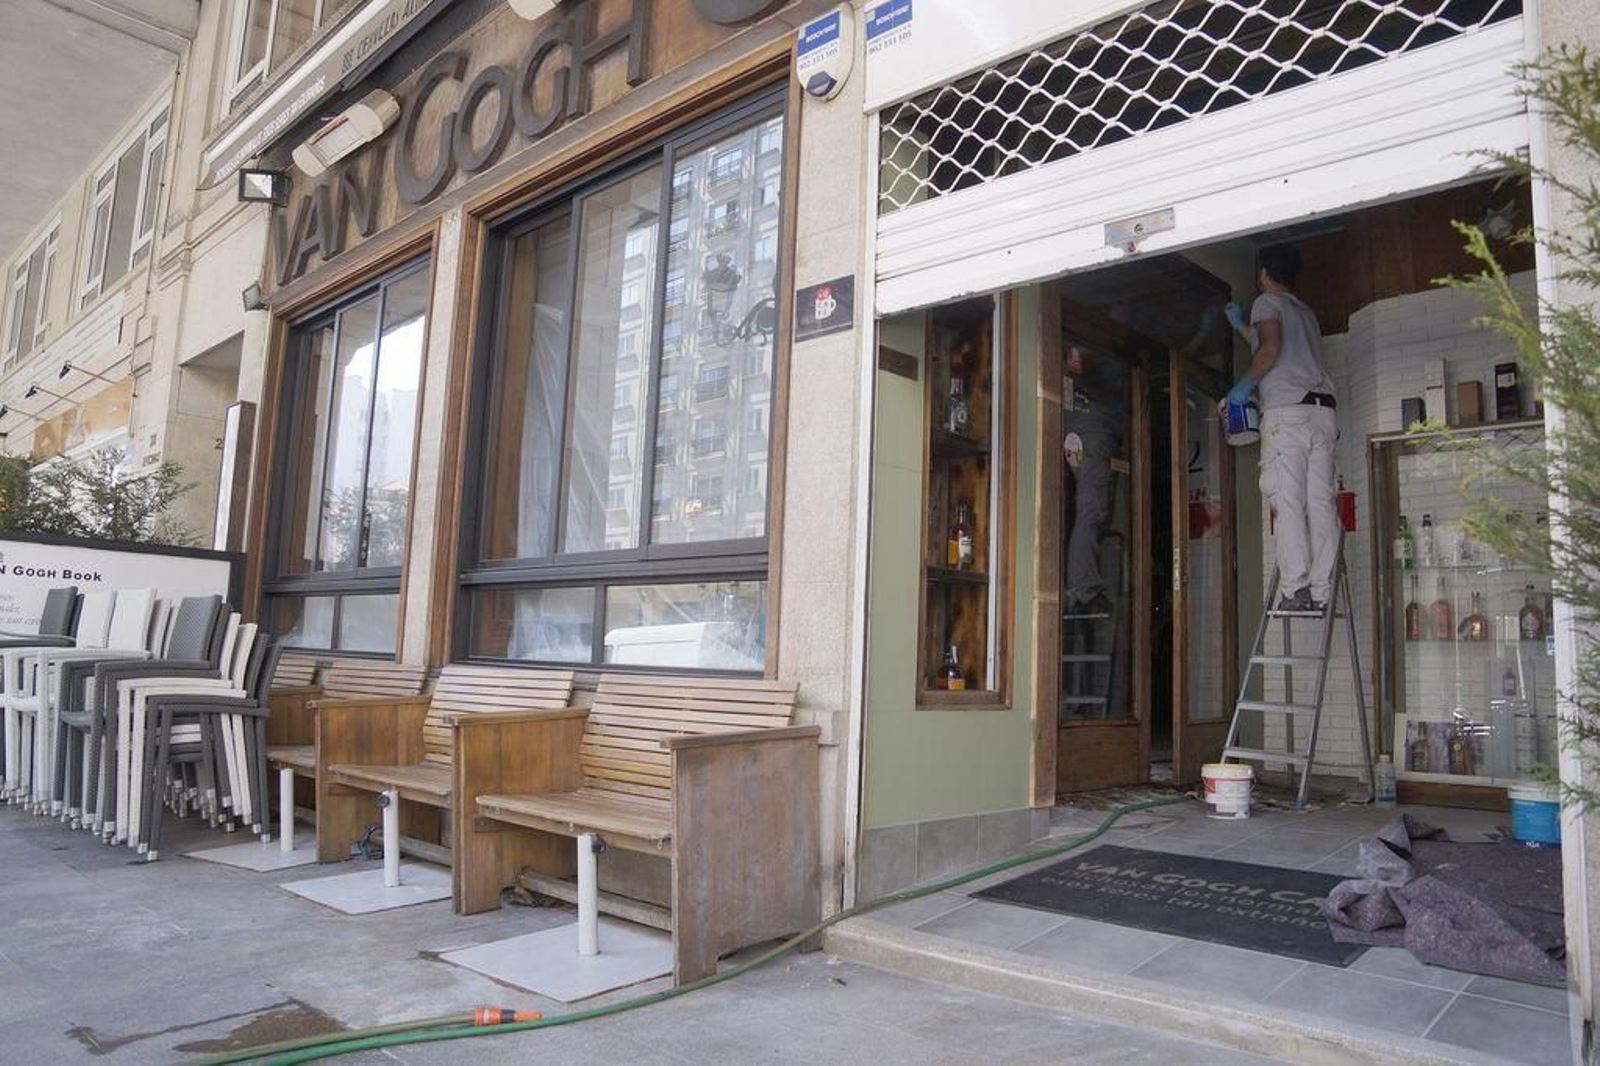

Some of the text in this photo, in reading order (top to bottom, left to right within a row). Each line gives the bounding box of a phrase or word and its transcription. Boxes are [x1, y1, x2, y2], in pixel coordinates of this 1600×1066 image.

[272, 143, 388, 287] VAN
[394, 0, 650, 206] GOGH
[62, 569, 102, 582] Book
[1077, 861, 1149, 878] VAN
[1152, 874, 1266, 896] GOGH
